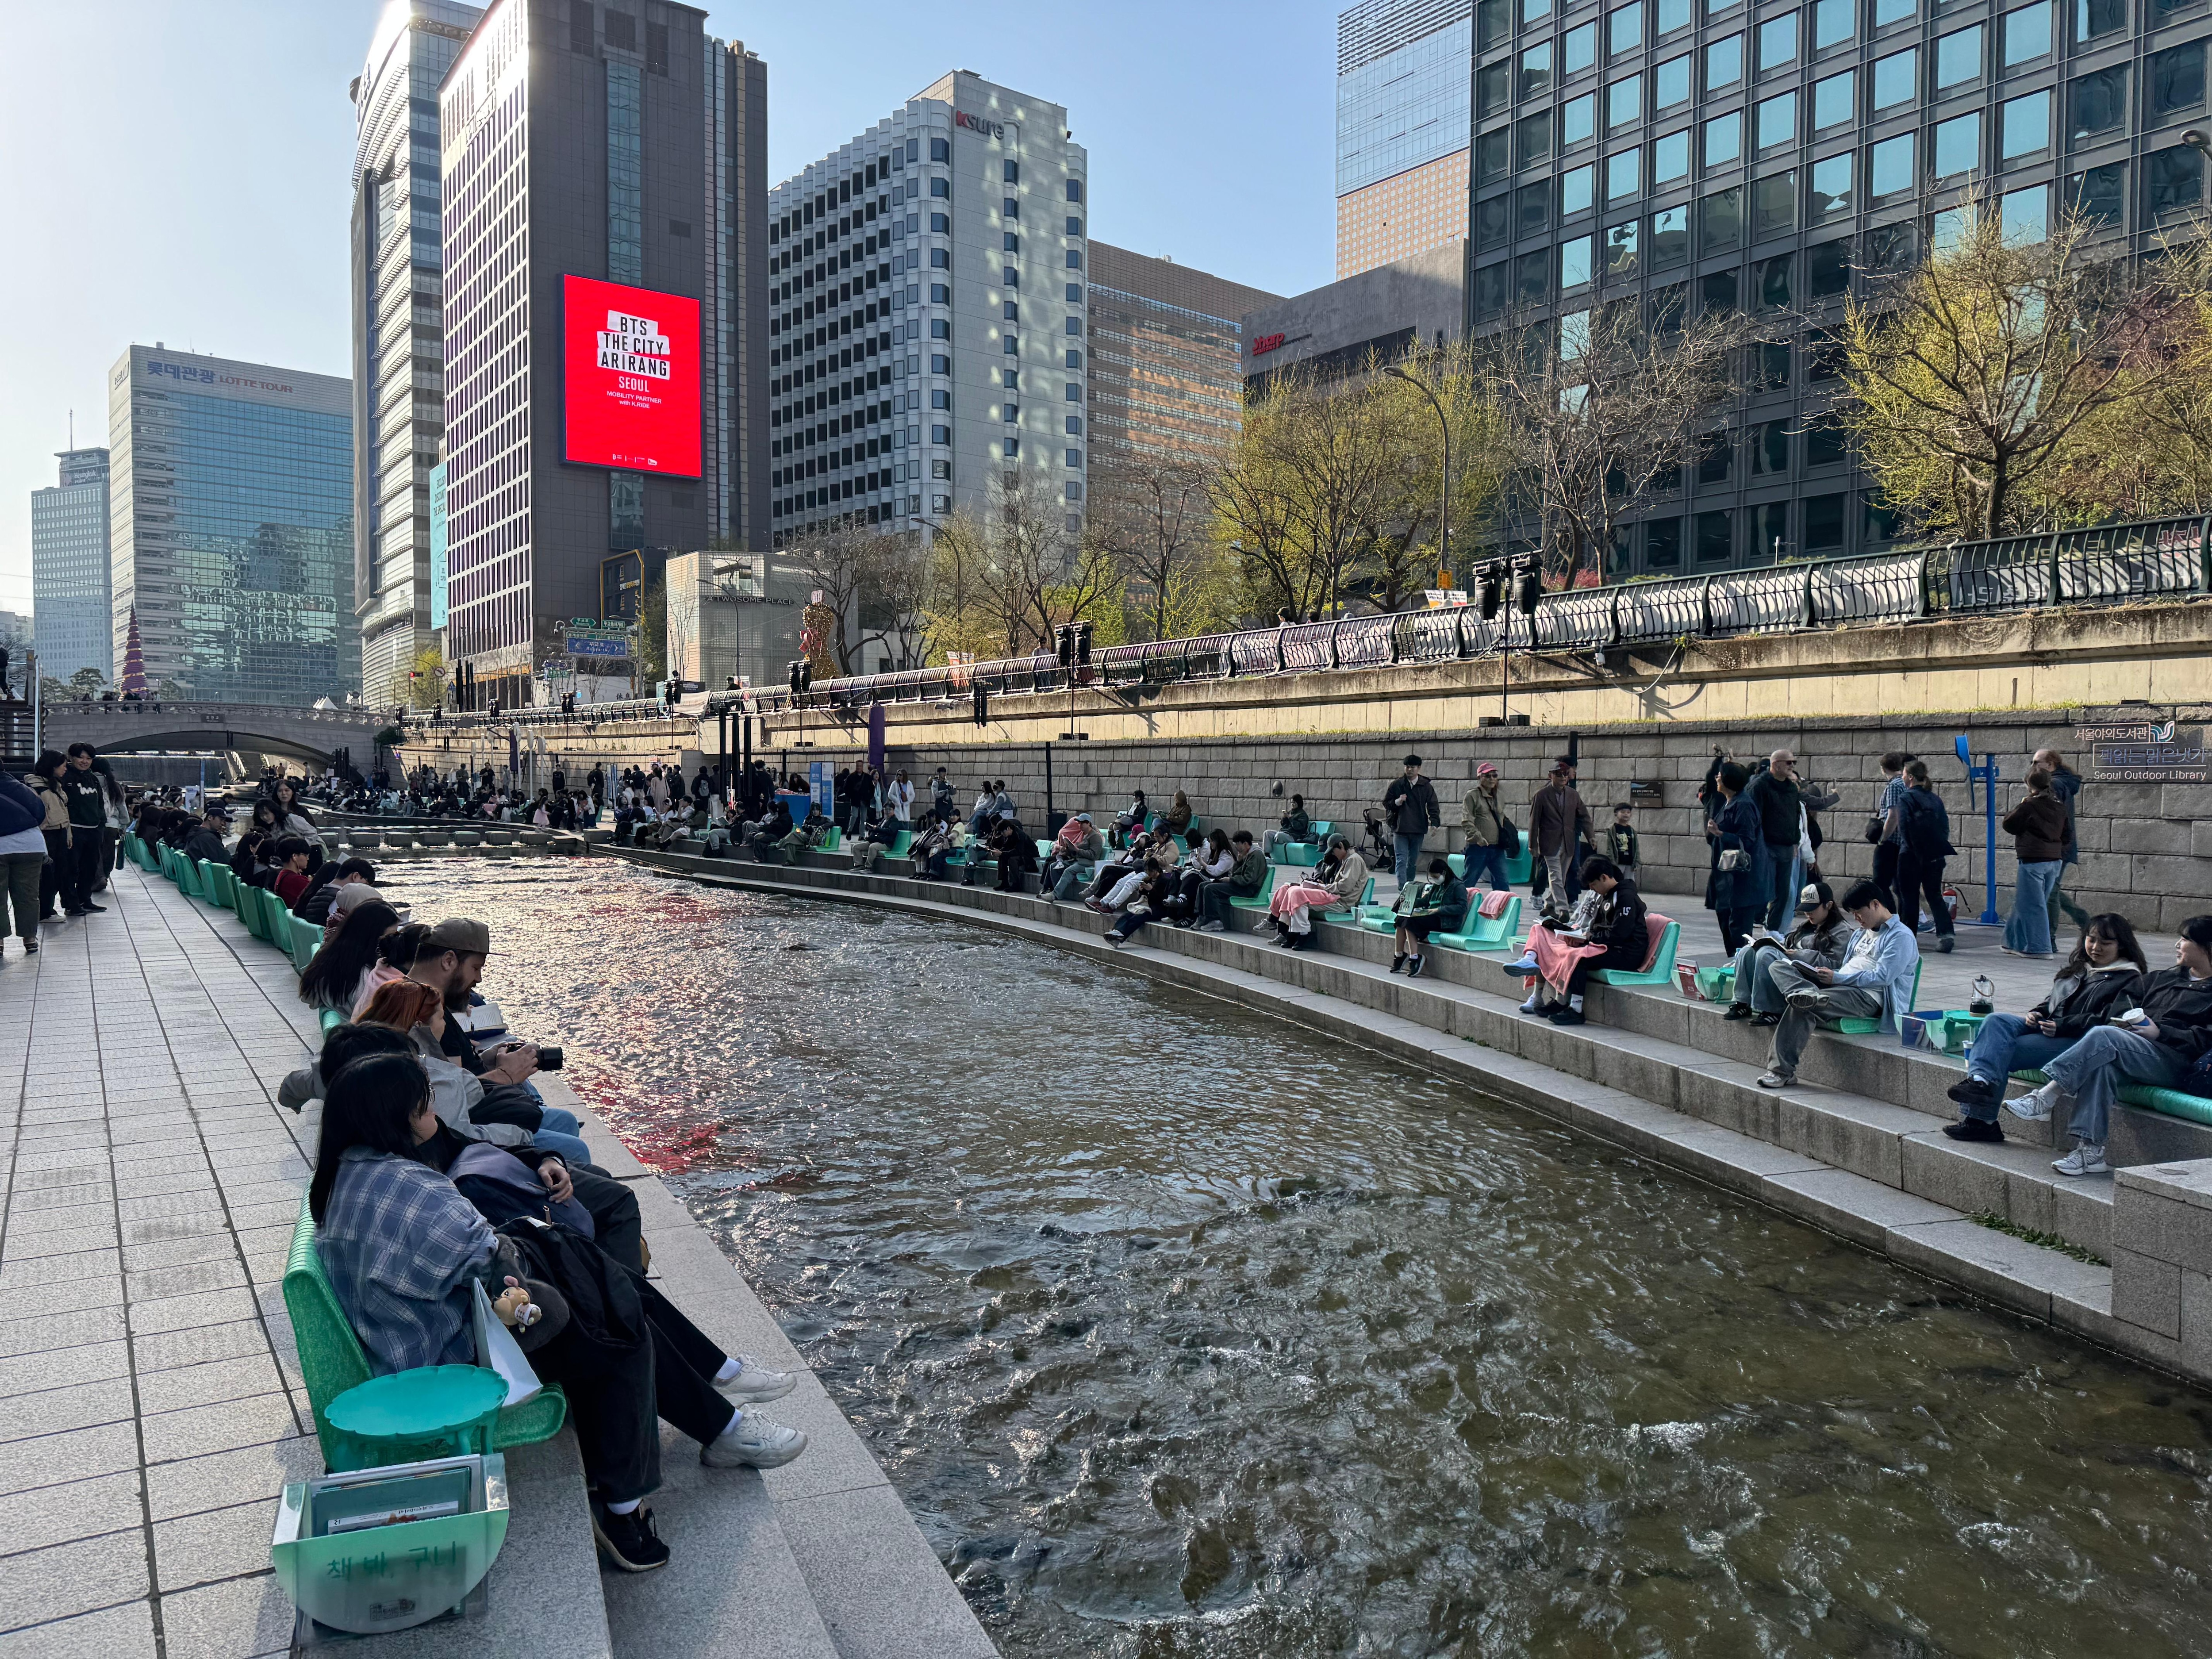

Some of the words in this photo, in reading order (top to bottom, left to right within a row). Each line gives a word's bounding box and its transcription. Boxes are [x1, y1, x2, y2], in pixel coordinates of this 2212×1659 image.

[620, 316, 647, 336] BTS
[603, 333, 628, 352] THE
[633, 338, 664, 357] CITY
[601, 351, 667, 376] ARIRANG
[147, 361, 215, 384] 롯데관광
[219, 375, 258, 388] LOTTE
[260, 380, 293, 393] TOUR
[618, 376, 649, 393] SEOUL
[607, 391, 634, 400] MOBILITY
[635, 395, 662, 404] PARTNER
[2074, 726, 2148, 741] 서울야외도서관
[2094, 771, 2121, 780] Seoul
[2124, 770, 2166, 780] Outdoor
[2170, 770, 2206, 781] Library
